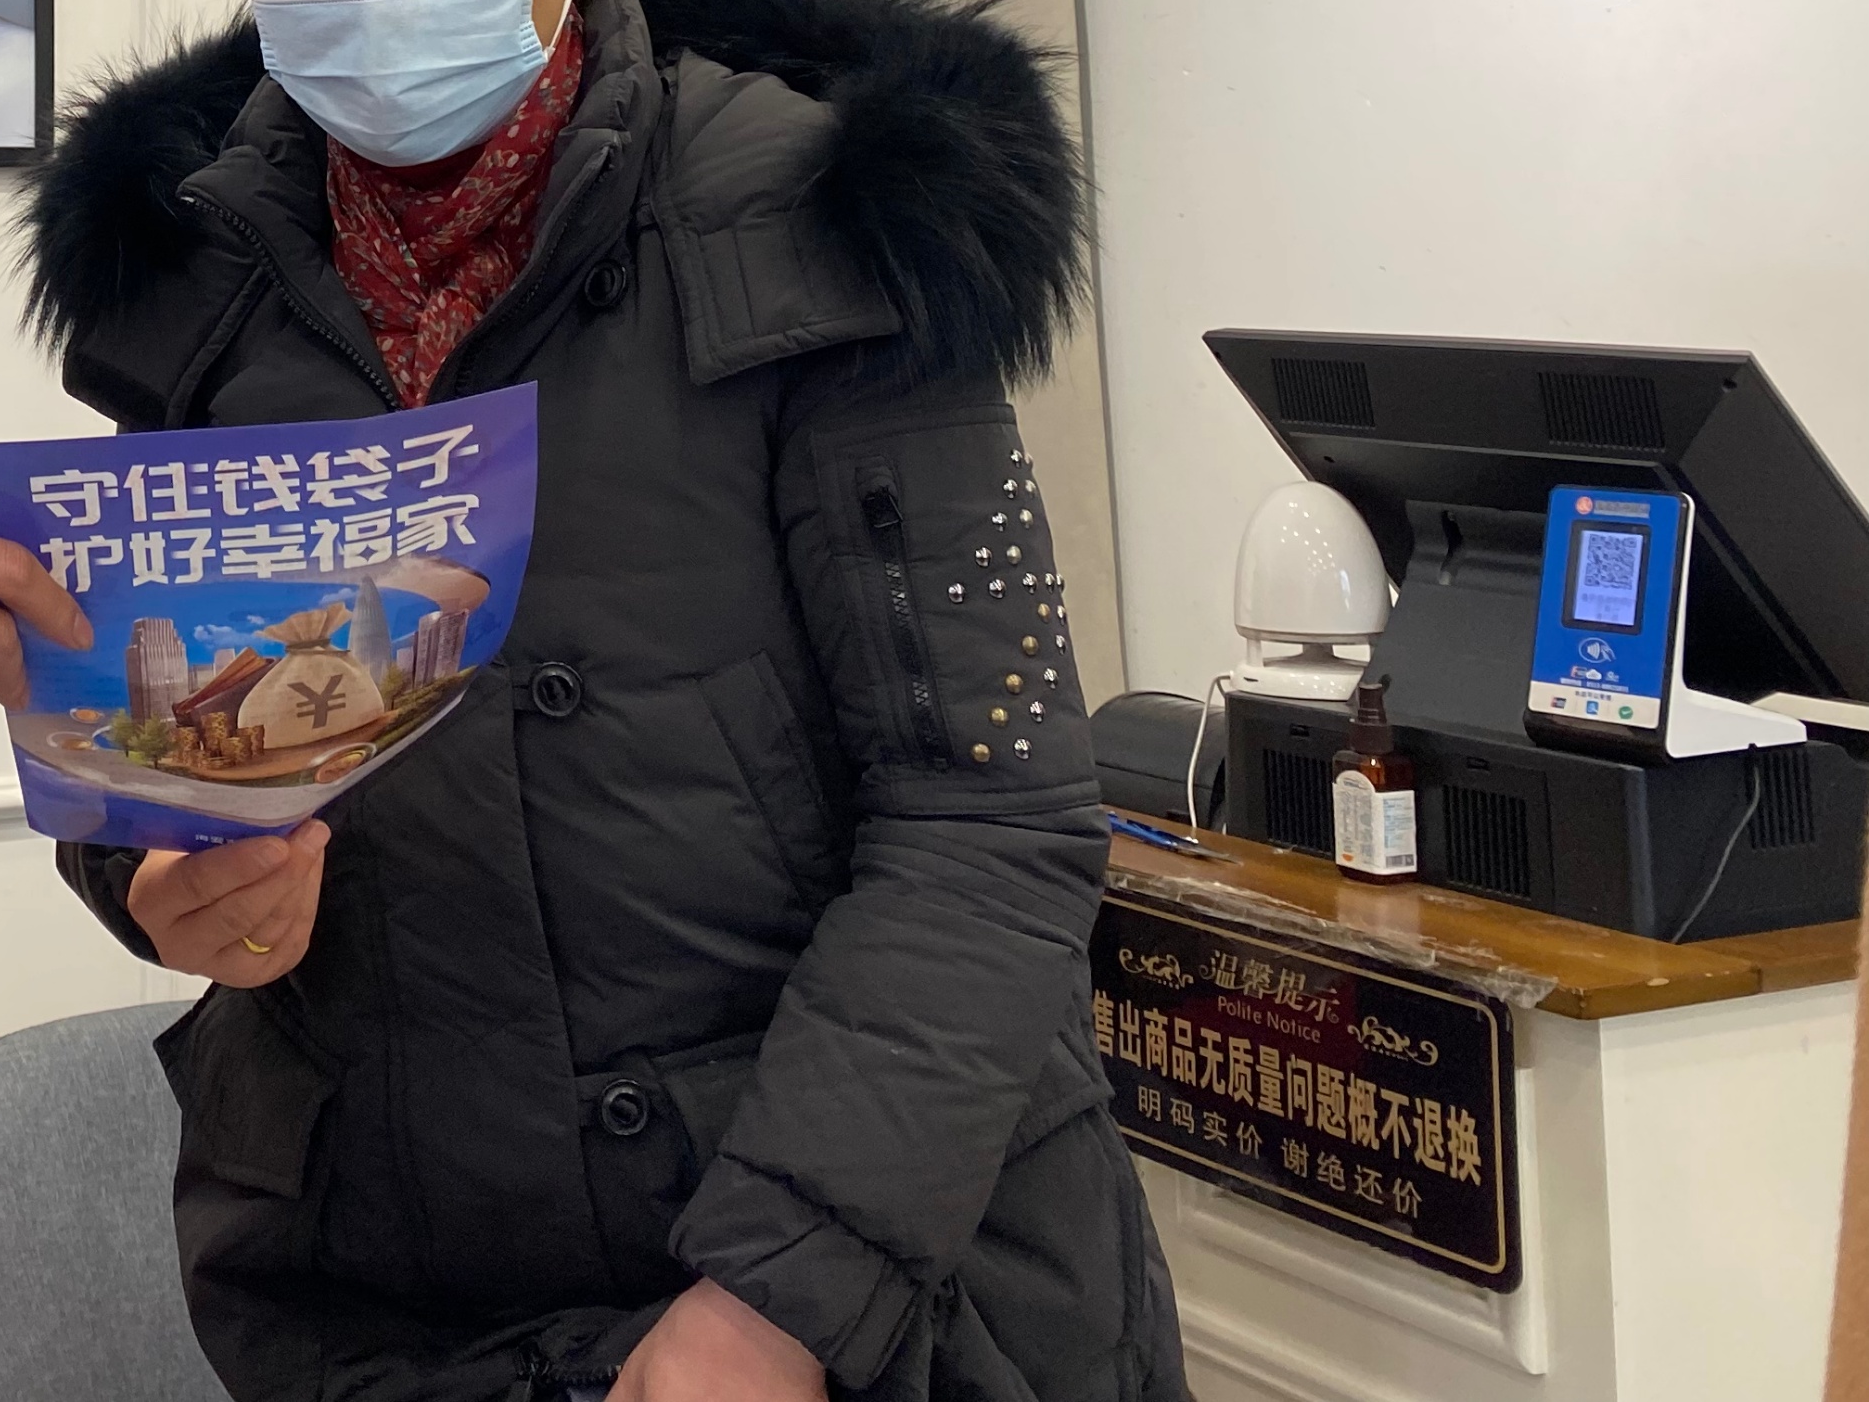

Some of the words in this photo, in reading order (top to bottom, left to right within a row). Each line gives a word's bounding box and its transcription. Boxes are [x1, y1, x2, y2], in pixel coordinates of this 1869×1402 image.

[29, 423, 480, 528] 守住钱袋子
[39, 493, 480, 594] 护好幸福家
[1199, 949, 1340, 1024] 温馨提示
[1217, 994, 1263, 1025] Polite
[1266, 1010, 1322, 1044] Notice
[1092, 988, 1482, 1187] 售出商品无质量问题概不退换
[1137, 1084, 1264, 1160] 明码实价
[1281, 1137, 1423, 1219] 谢绝还价
